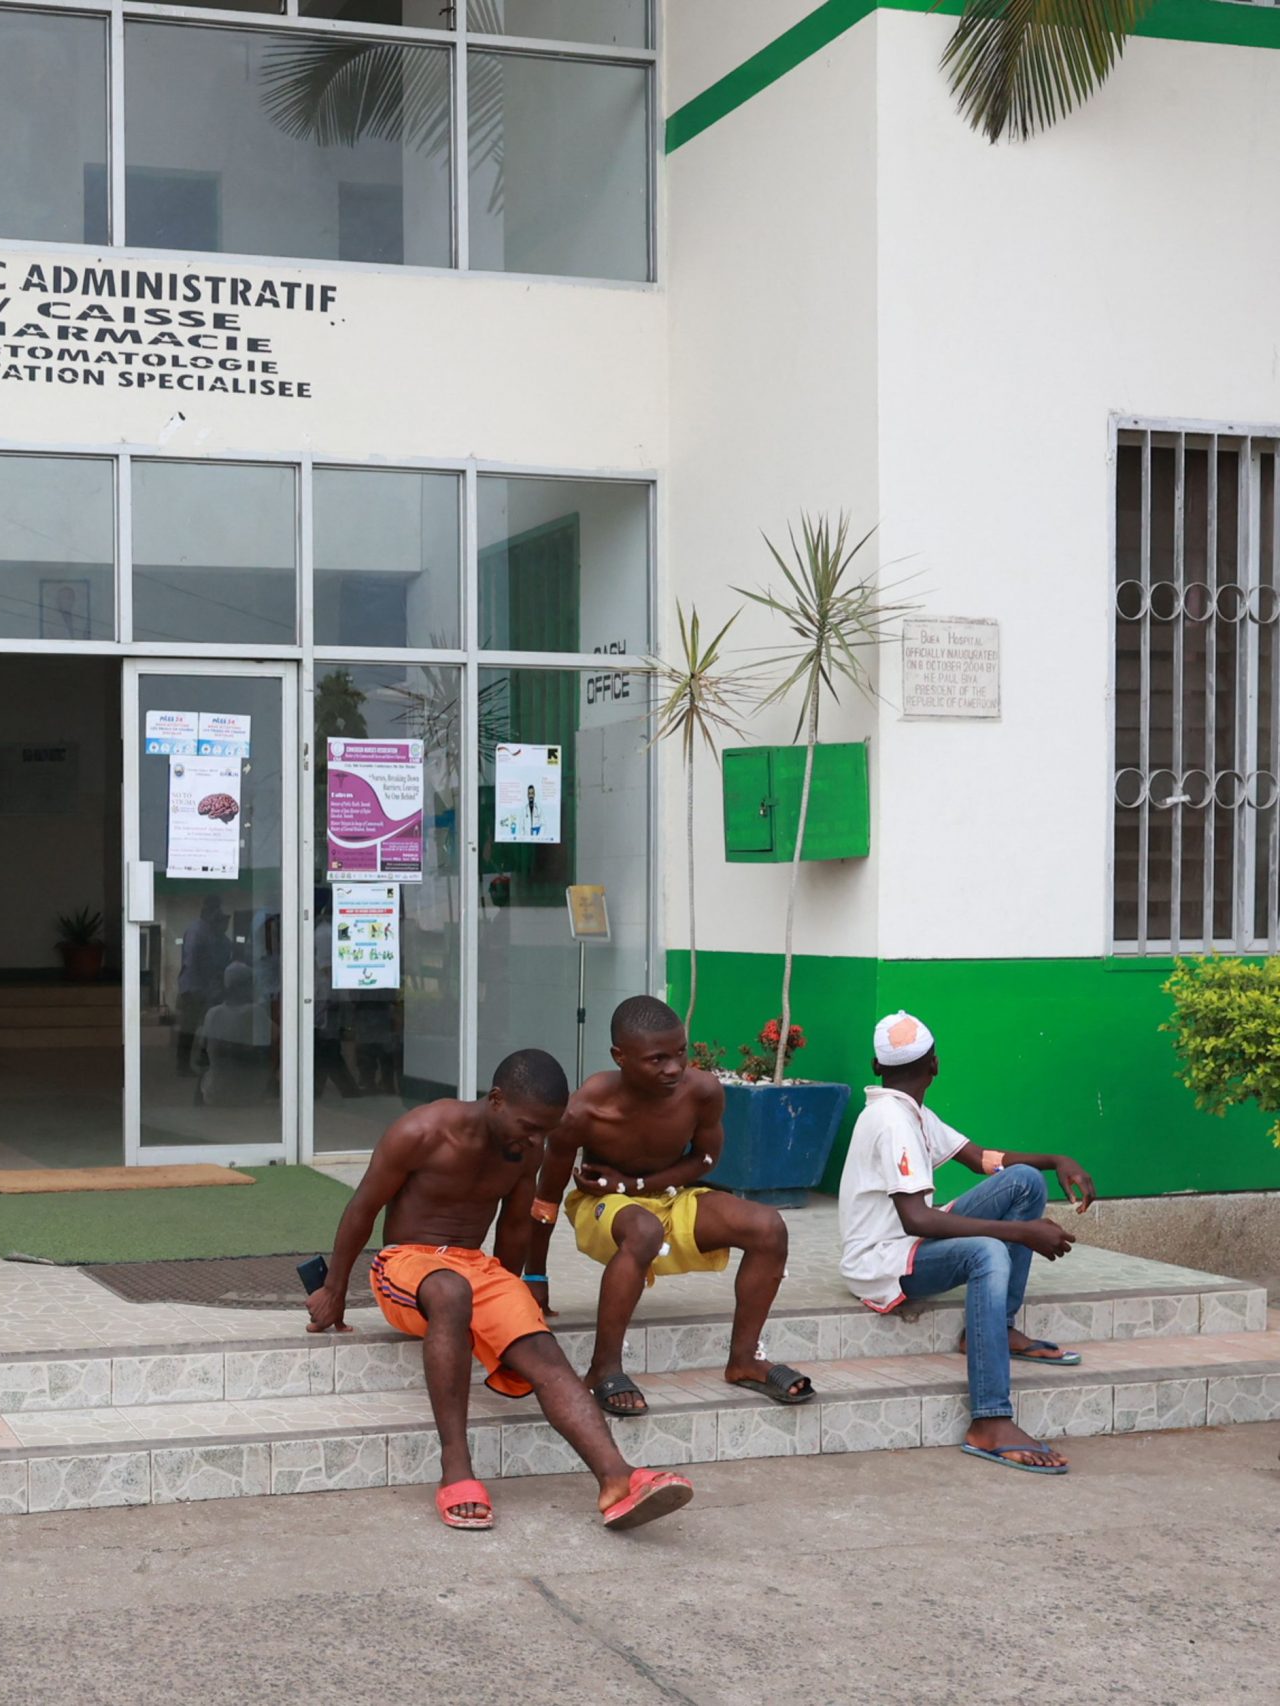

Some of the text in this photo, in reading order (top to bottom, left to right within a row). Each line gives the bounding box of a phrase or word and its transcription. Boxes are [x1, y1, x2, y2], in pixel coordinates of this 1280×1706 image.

[22, 263, 337, 313] ADMINISTRATIF
[37, 302, 241, 331] CAISSE
[118, 370, 312, 398] SPECIALISEE
[587, 672, 630, 704] OFFICE
